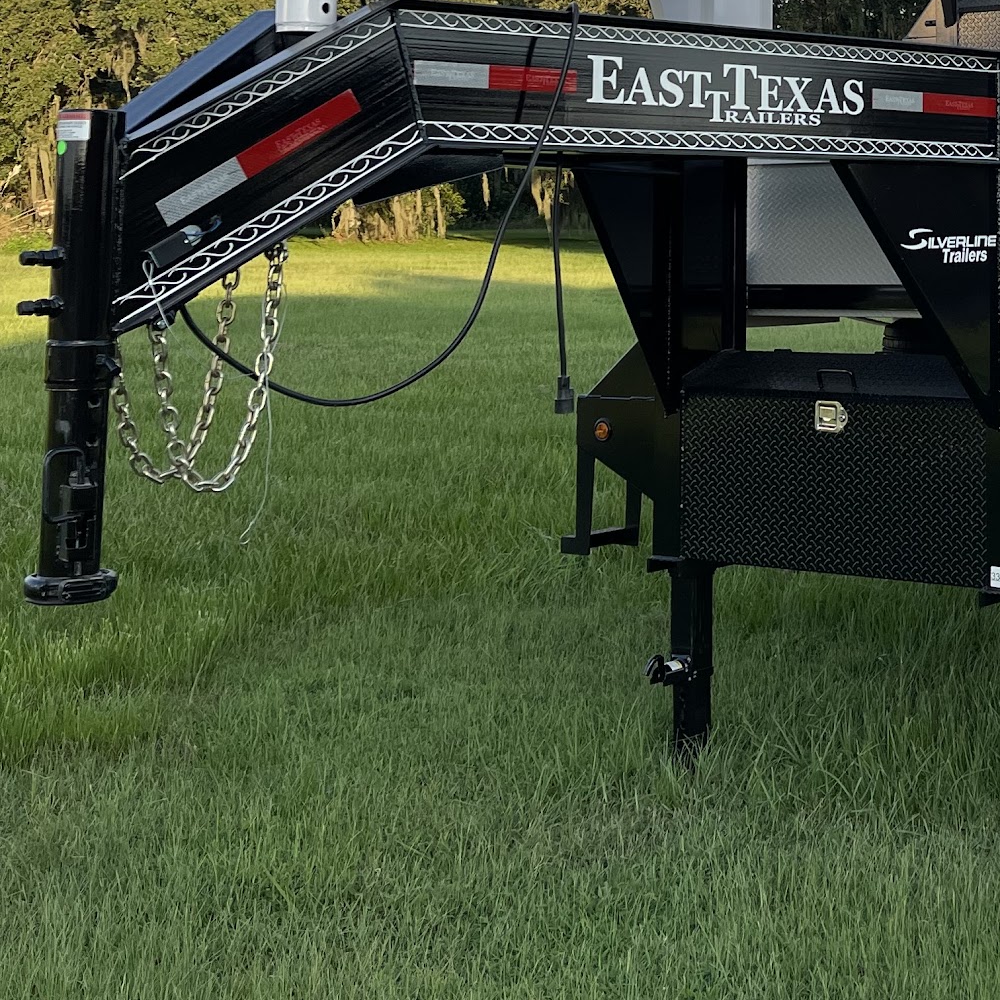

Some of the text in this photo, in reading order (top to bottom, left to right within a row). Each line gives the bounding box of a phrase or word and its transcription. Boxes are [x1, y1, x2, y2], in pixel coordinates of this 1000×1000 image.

[586, 54, 865, 116] EAST TEXAS
[705, 90, 822, 127] TRAILERS
[900, 228, 997, 251] SILVERLINE
[942, 247, 988, 264] Trailers
